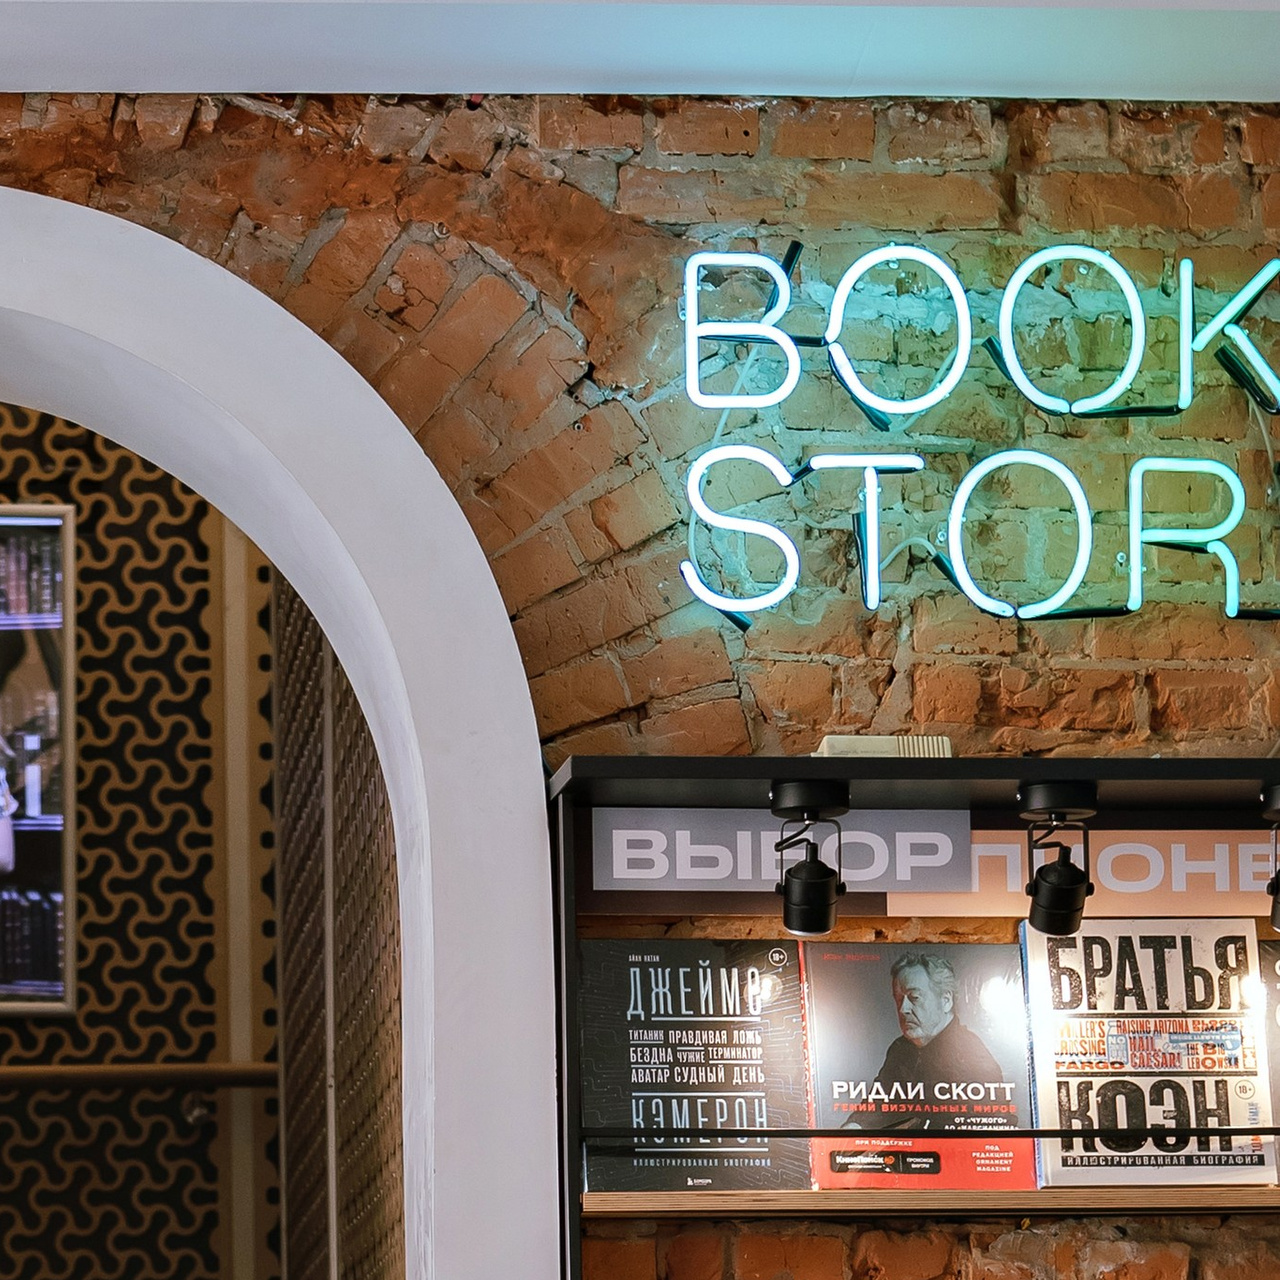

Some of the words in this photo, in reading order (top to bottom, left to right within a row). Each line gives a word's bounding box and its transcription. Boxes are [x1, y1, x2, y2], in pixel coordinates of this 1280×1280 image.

[683, 243, 1280, 416] BOOK
[1046, 935, 1250, 1011] БРАТЬЯ
[626, 960, 762, 1021] ДЖЕЙМС
[1153, 1019, 1190, 1034] ARIZONA
[628, 1030, 664, 1041] ТИТАНИК
[669, 1030, 727, 1046] ПРАВДИВАЯ
[733, 1030, 762, 1044] ЛОЖЬ
[630, 1048, 673, 1064] БЕЗДНА
[677, 1052, 705, 1063] ЧУЖИЕ
[708, 1047, 763, 1059] ТЕРМИНАТОР
[1055, 1060, 1125, 1070] FARGO
[631, 1069, 670, 1083] АВАТАР
[674, 1064, 725, 1085] СУДНЫЙ
[733, 1067, 766, 1085] ДЕНЬ
[832, 1080, 925, 1104] РИДЛИ
[933, 1082, 1016, 1101] СКОТТ
[881, 1103, 968, 1113] ВИЗУАЛЬНЫХ
[973, 1104, 1017, 1113] МИРОВ
[1056, 1079, 1234, 1154] КОЭН
[631, 1098, 769, 1143] КЭМЕРОН
[1067, 1155, 1186, 1166] ИЛЛЮСТРИРОВАННАЯ
[1192, 1154, 1259, 1166] БИОГРАФИЯ
